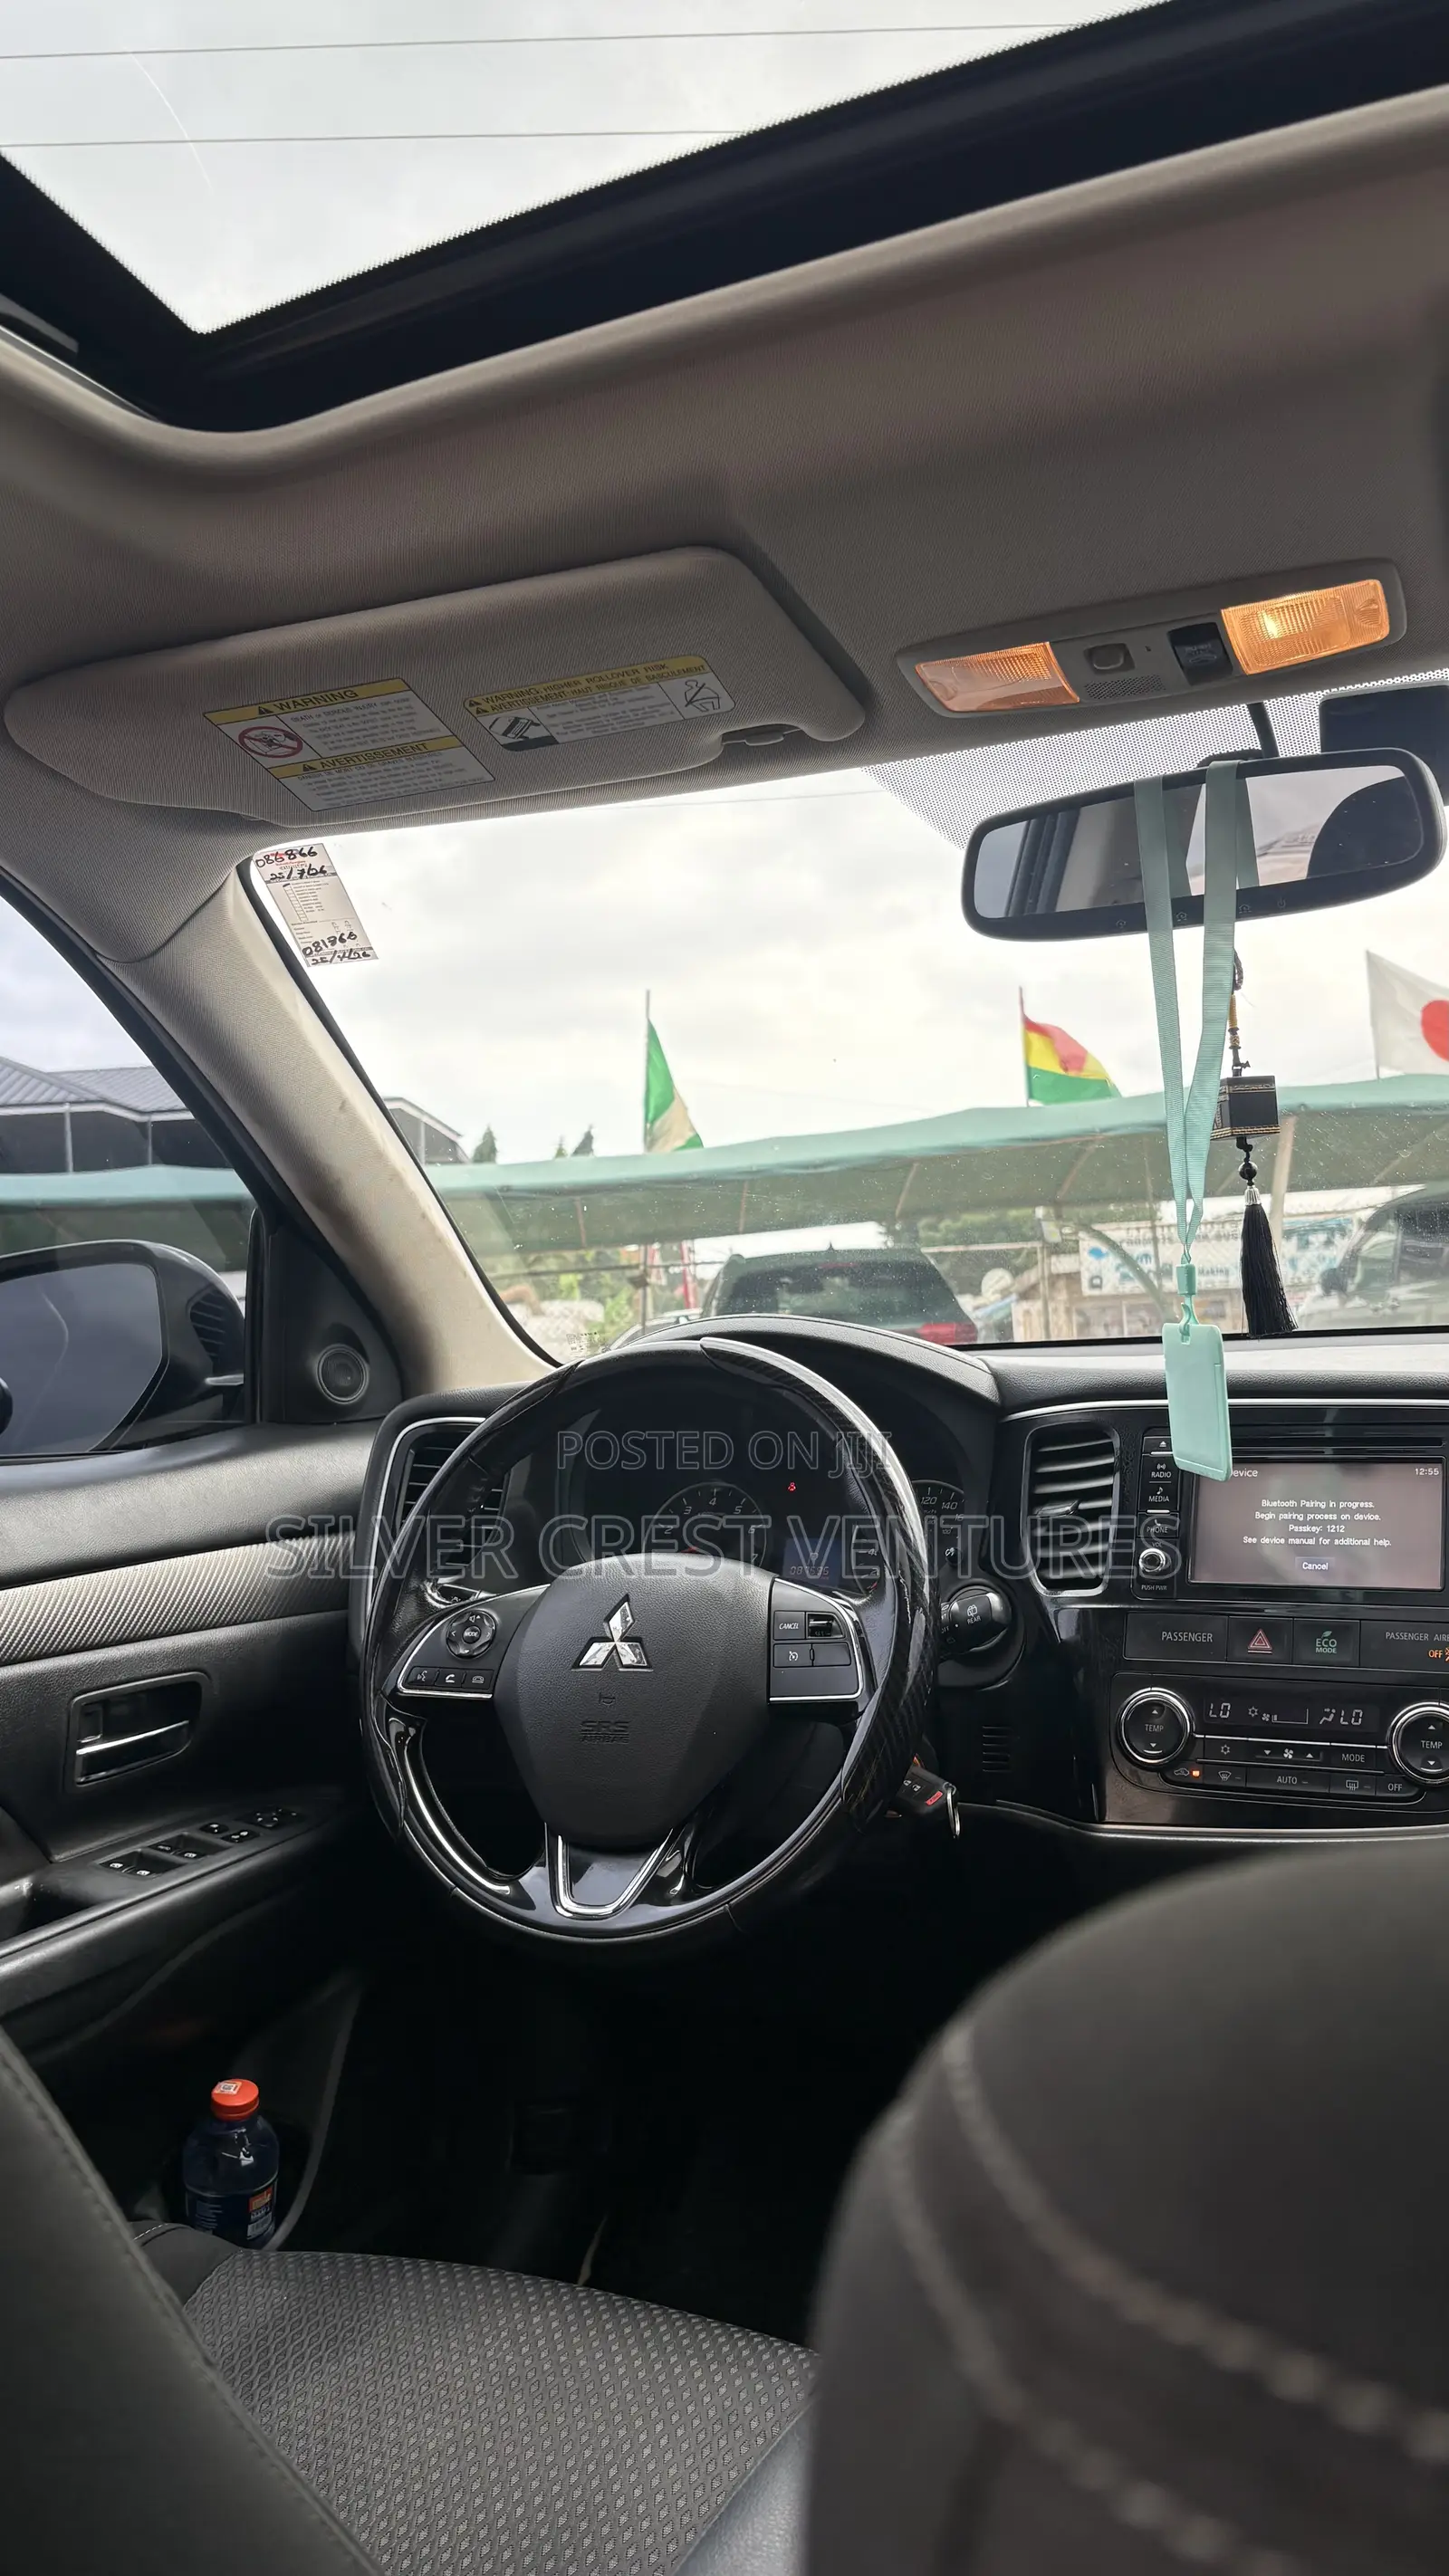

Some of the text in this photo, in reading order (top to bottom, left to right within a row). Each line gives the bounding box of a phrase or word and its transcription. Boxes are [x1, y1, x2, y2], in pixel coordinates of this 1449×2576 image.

[273, 689, 360, 712] WARNING
[320, 742, 429, 770] AVERTISSEMENT
[1231, 1468, 1259, 1478] evice
[1415, 1468, 1440, 1476] 12:55
[708, 1497, 717, 1506] 4
[920, 1496, 937, 1505] 120
[941, 1501, 958, 1510] 140
[1262, 1499, 1375, 1509] Bluetooth Pairing in progress.
[683, 1506, 693, 1515] 3
[733, 1505, 743, 1515] 5
[1254, 1511, 1382, 1521] Begin pairing process on device.
[664, 1526, 674, 1535] 2
[1289, 1524, 1346, 1534] Passkey: 1212
[1243, 1536, 1392, 1547] See device manual for additional help.
[1302, 1561, 1329, 1571] Cancel
[966, 1614, 982, 1625] REAR
[1161, 1631, 1214, 1643] PASSENGER
[1385, 1632, 1429, 1642] PASSENGER
[1316, 1638, 1338, 1648] ECO
[1428, 1649, 1444, 1659] OFF
[1144, 1724, 1164, 1733] TEMP
[1421, 1740, 1443, 1749] TEMP
[1341, 1753, 1366, 1763] MODE
[1276, 1776, 1298, 1785] AUTO
[1387, 1783, 1403, 1792] OFF
